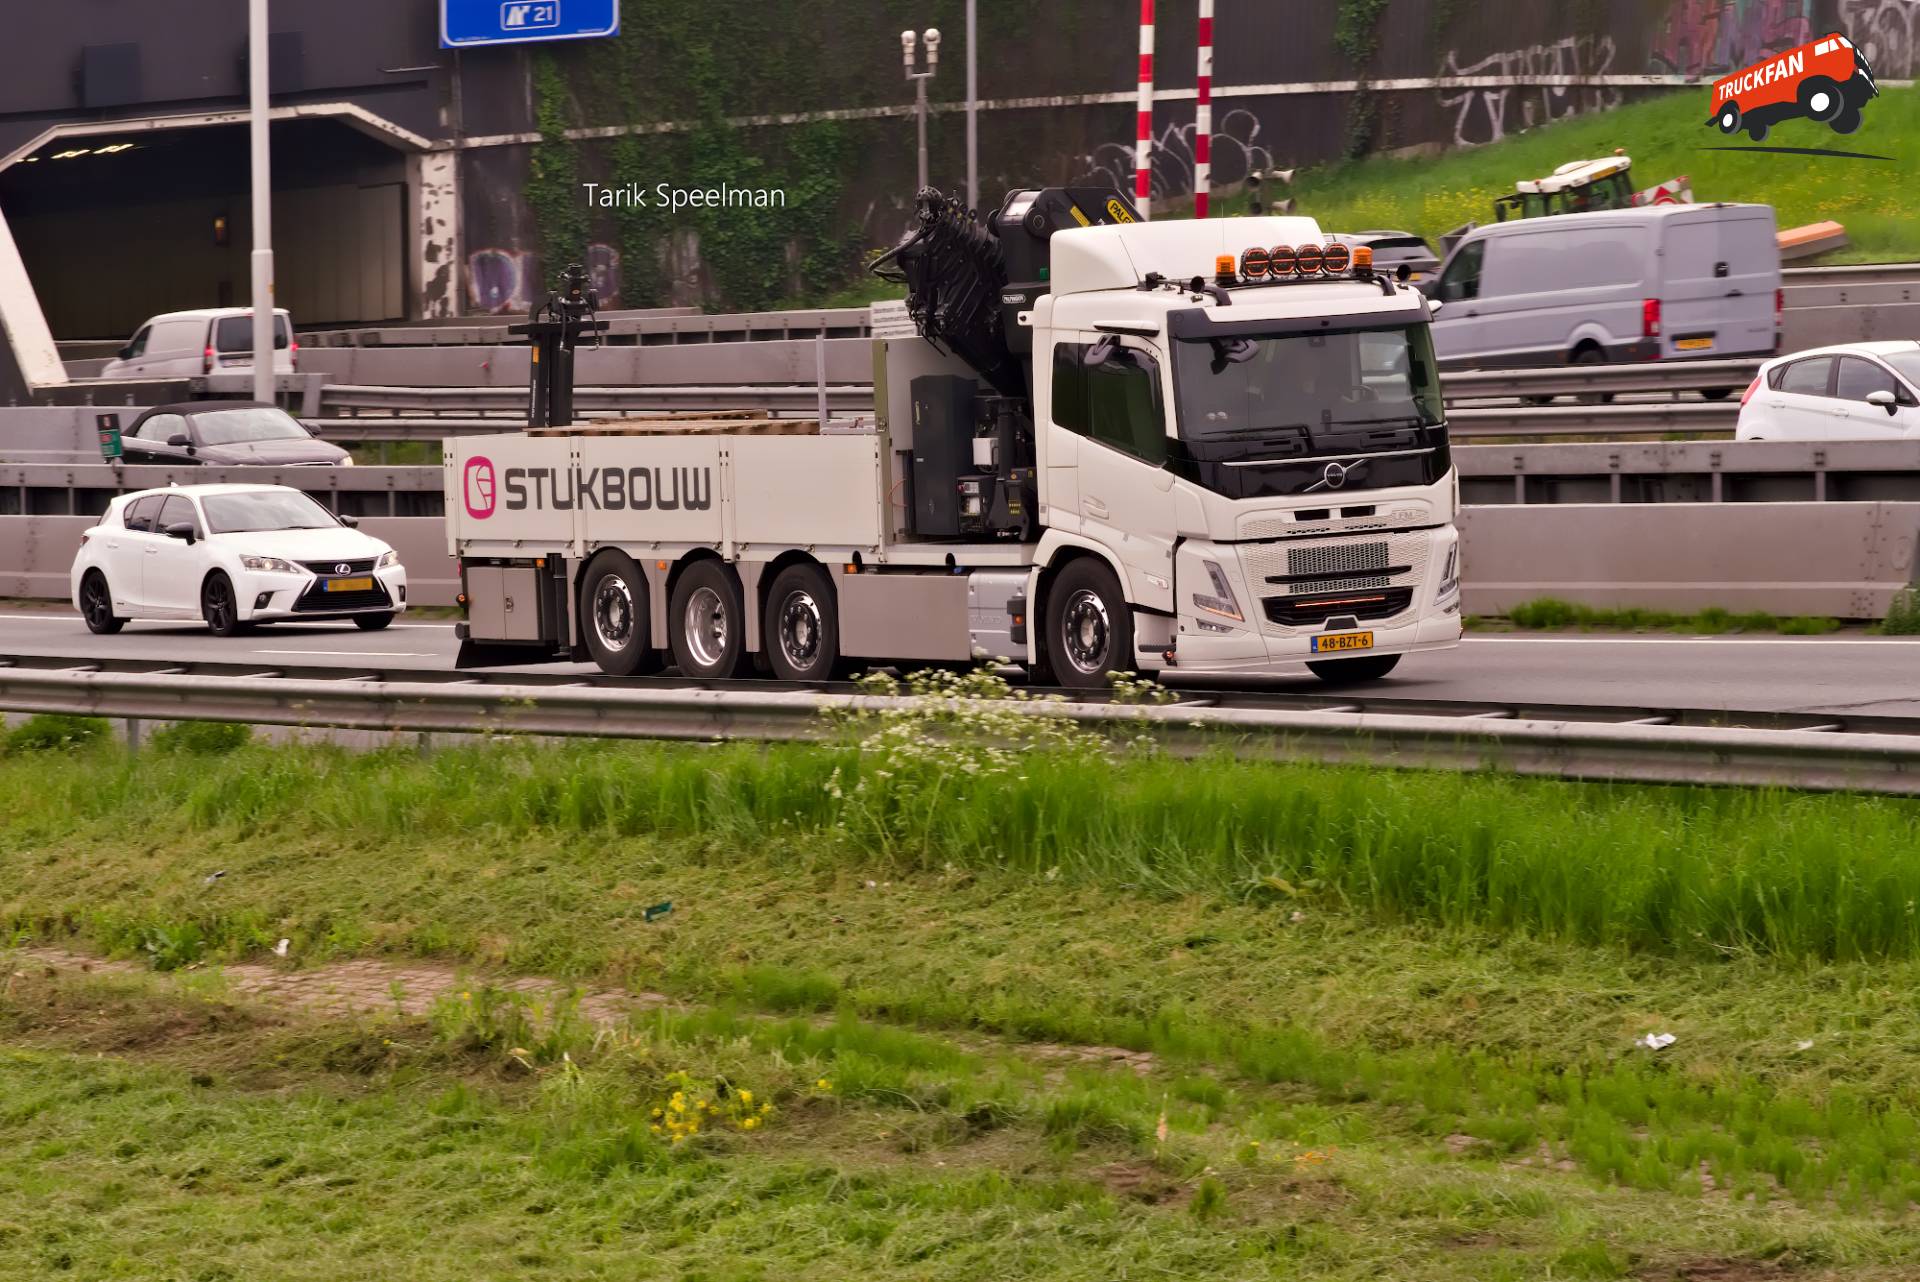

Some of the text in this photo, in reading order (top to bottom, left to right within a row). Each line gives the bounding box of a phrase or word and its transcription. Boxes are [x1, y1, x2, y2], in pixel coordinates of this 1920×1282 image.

[534, 6, 553, 21] 21
[1110, 202, 1132, 224] PALF
[504, 467, 711, 510] STUKBOUW
[1322, 635, 1368, 649] 48-BZT-6
